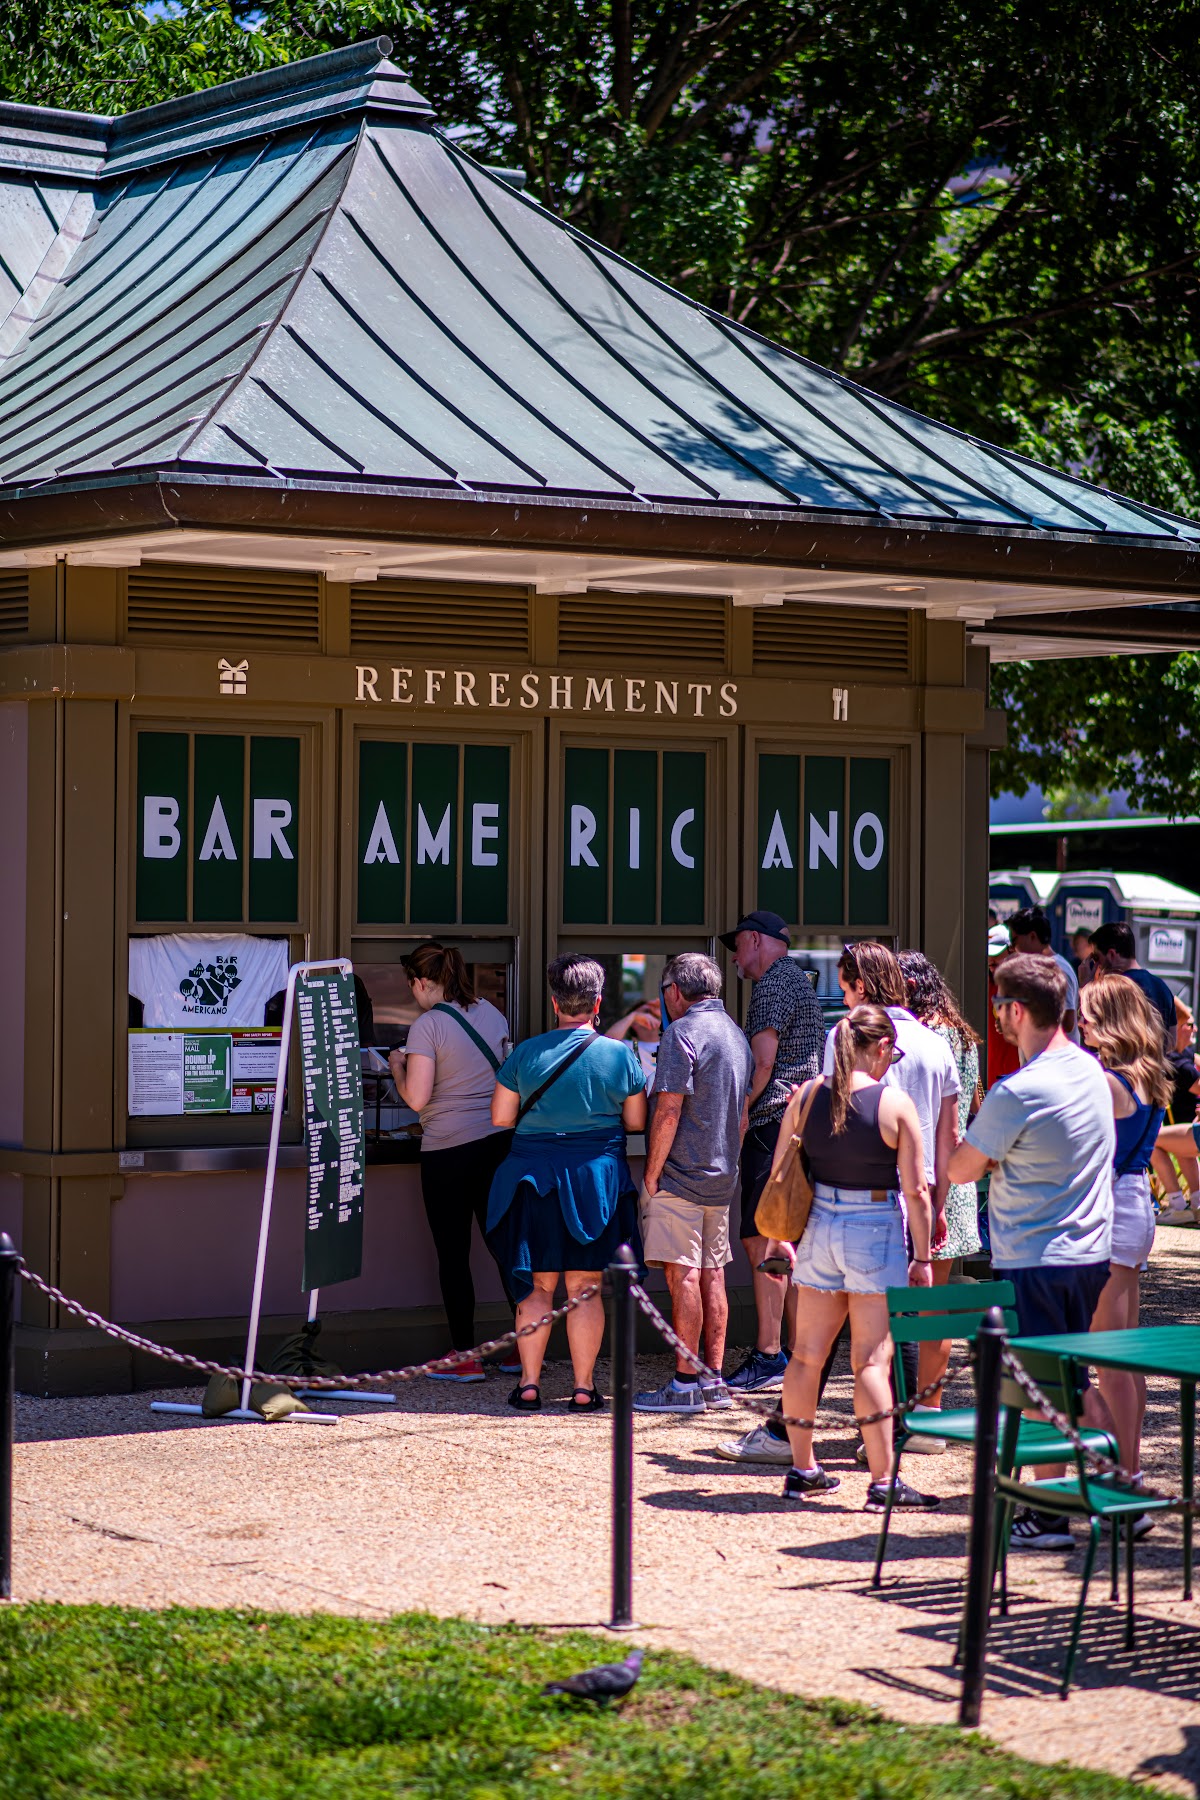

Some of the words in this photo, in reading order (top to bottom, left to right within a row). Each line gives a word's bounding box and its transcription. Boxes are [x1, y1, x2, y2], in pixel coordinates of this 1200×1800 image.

[355, 665, 738, 717] REFRESHMENTS
[143, 795, 295, 861] BAR
[1070, 906, 1100, 918] United
[1155, 937, 1183, 948] United
[216, 955, 238, 965] BAR
[182, 1005, 228, 1015] AMERICANO
[185, 1055, 206, 1064] ROUND
